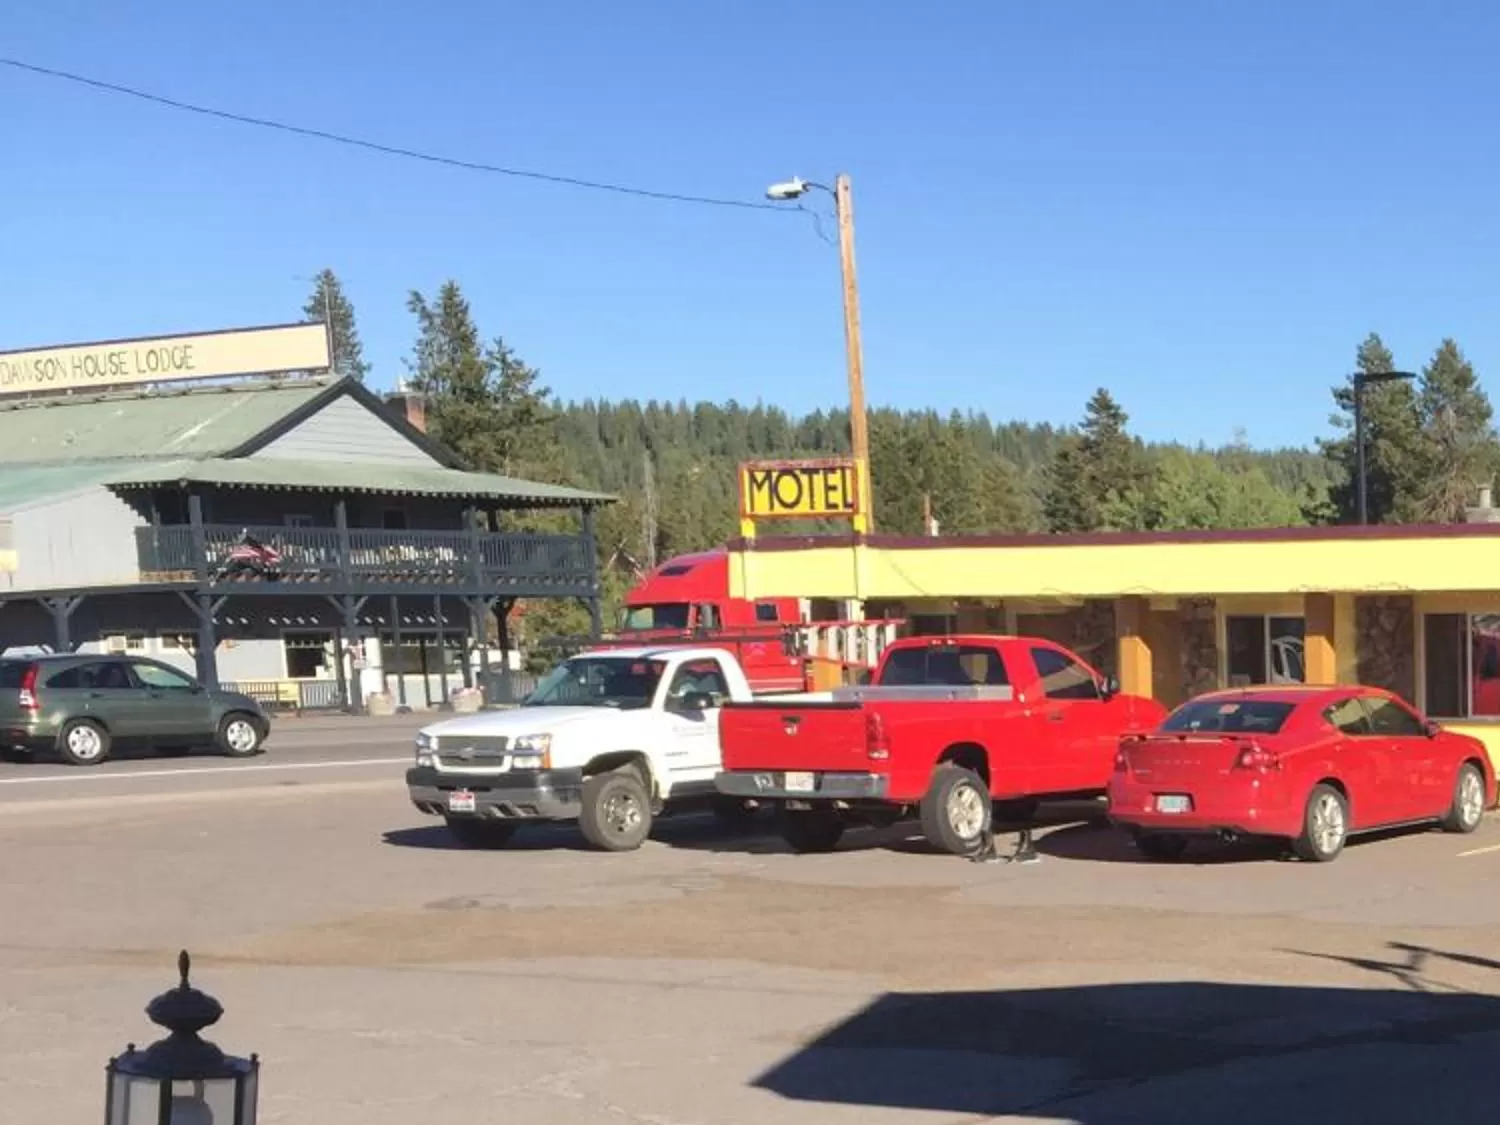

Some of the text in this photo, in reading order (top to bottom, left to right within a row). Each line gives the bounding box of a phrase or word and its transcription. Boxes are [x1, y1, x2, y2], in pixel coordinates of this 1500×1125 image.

[71, 350, 129, 379] HOUSE
[135, 344, 196, 374] LODGE
[748, 467, 854, 512] MOTEL
